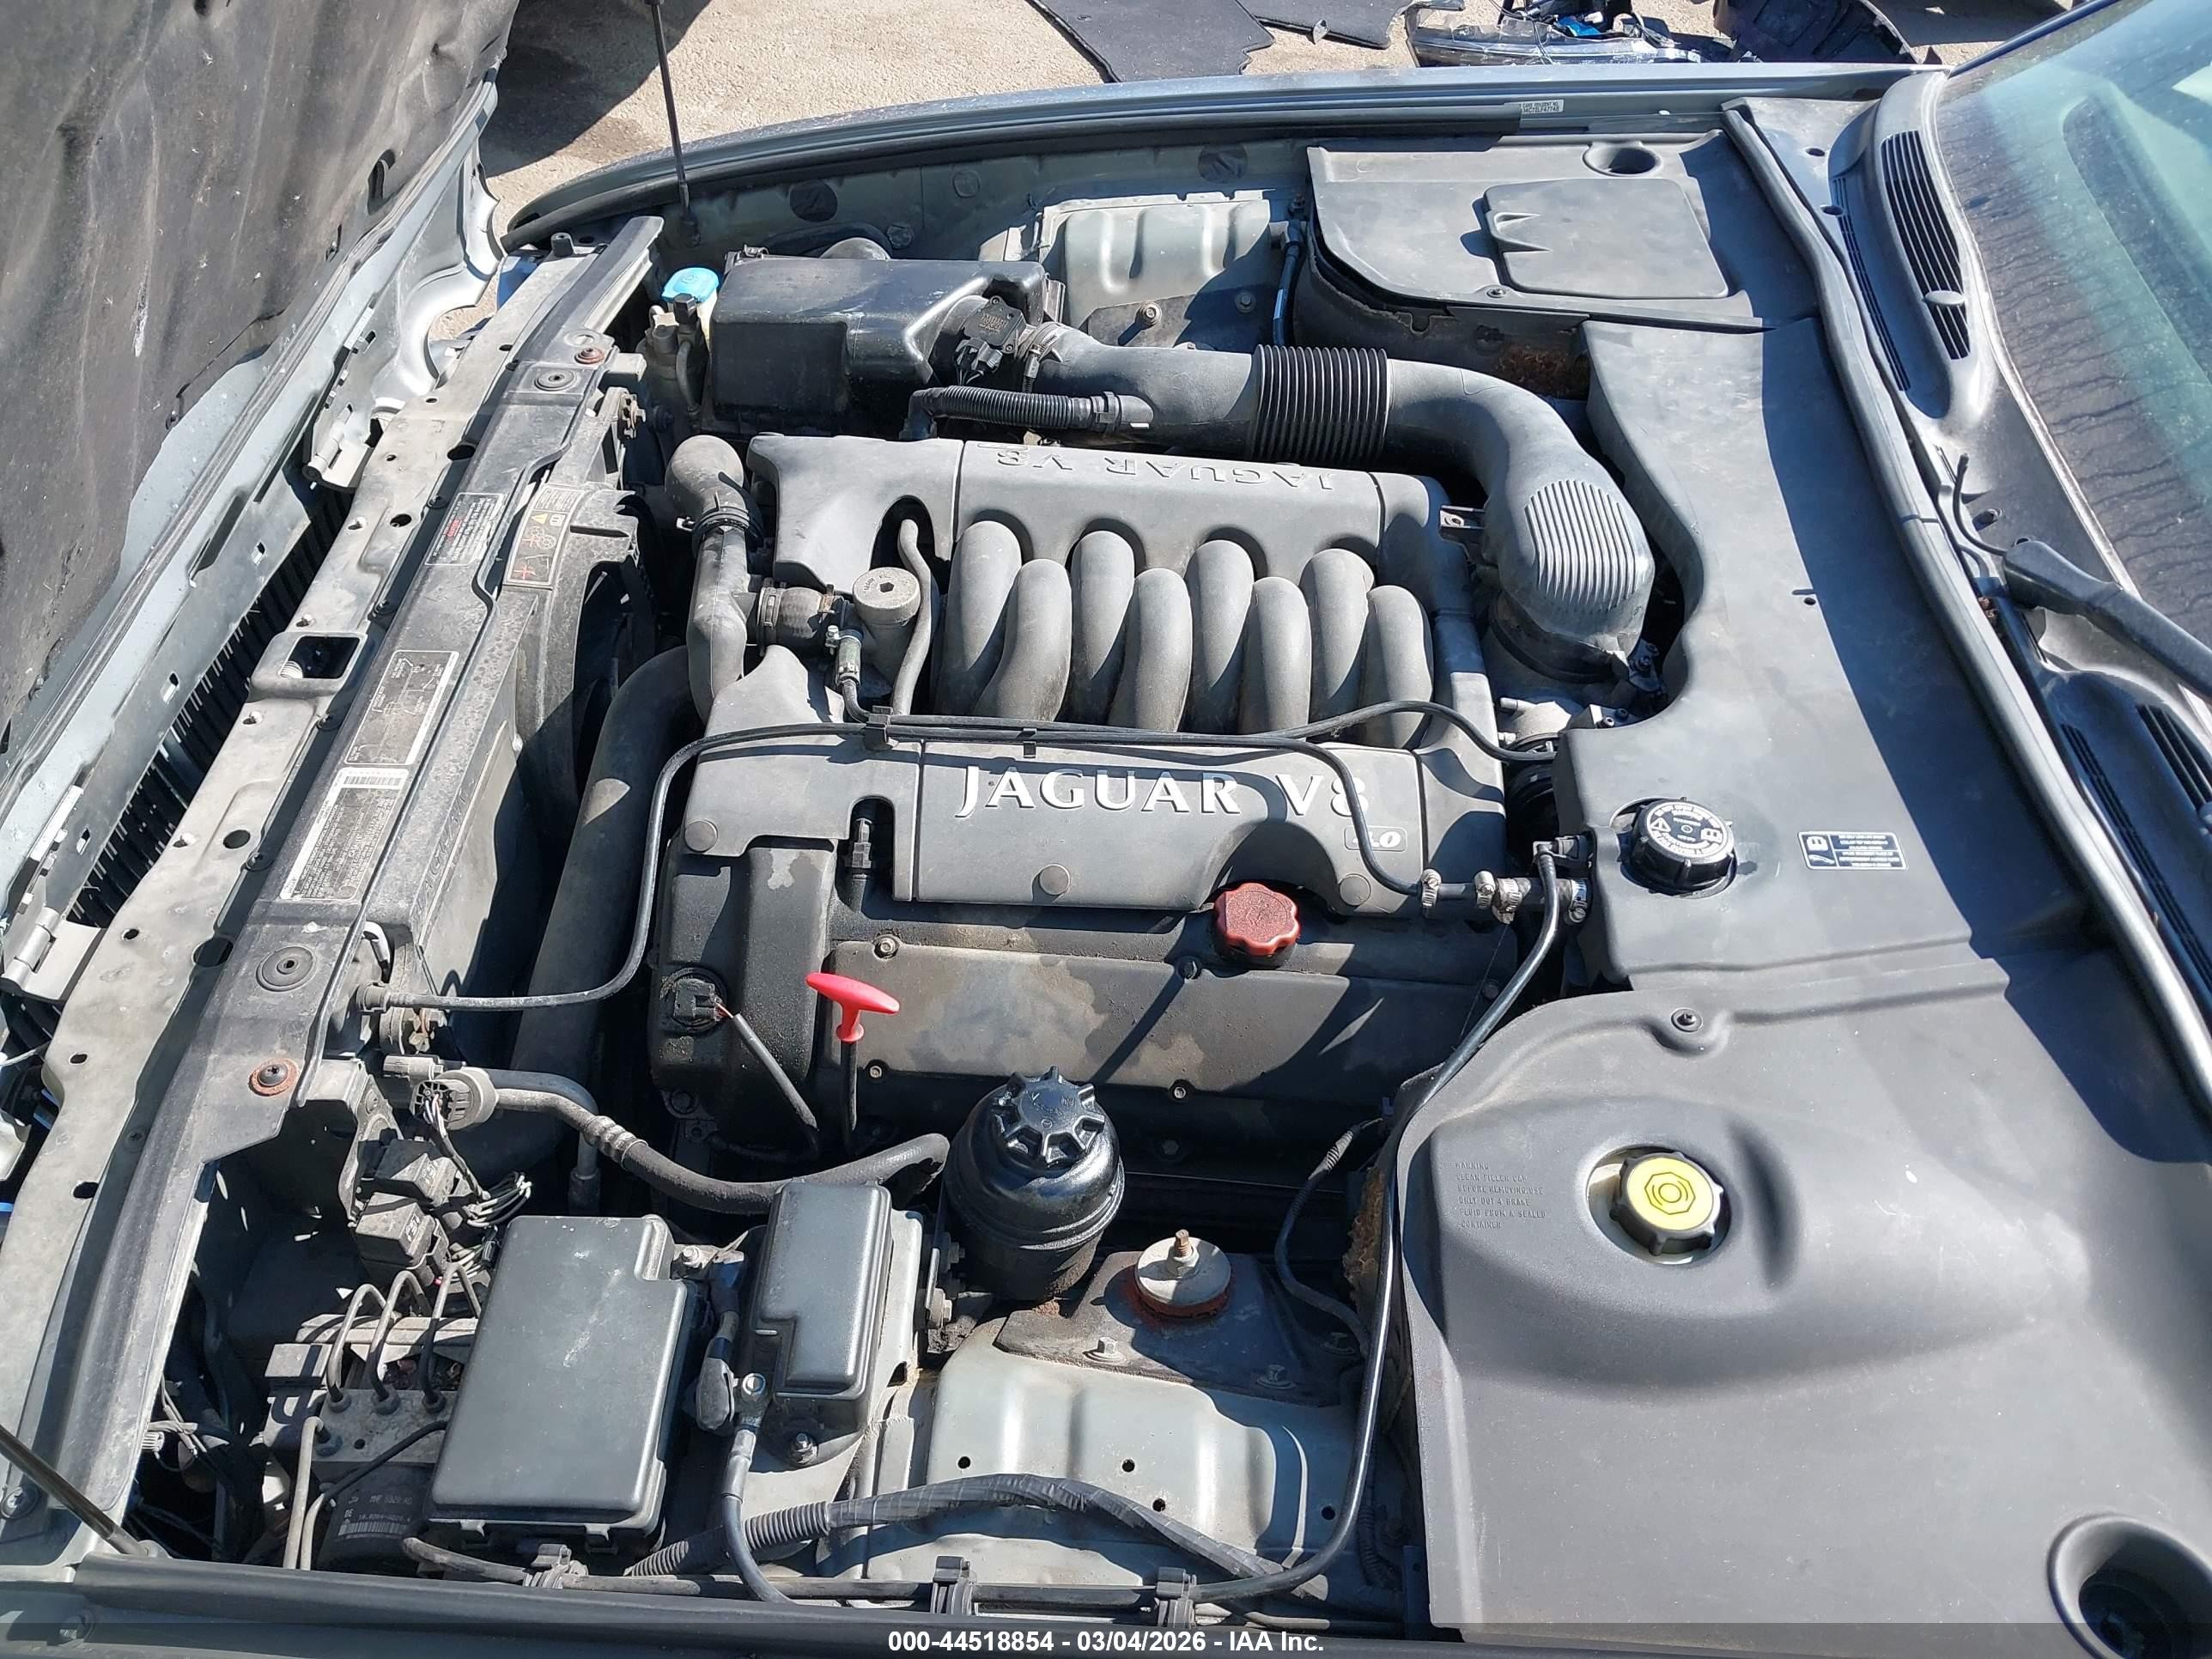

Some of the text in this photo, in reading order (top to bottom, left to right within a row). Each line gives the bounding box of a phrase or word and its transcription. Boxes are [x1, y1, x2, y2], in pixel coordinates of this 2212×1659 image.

[996, 449, 1334, 489] JAGUAR V8
[954, 765, 1370, 818] JAGUAR V8
[1455, 1161, 1489, 1170] WARNING
[1456, 1173, 1480, 1182] CLEAN
[1459, 1196, 1478, 1205] ONLY
[1480, 1197, 1494, 1206] DOT
[1506, 1198, 1530, 1206] BRAKE
[1460, 1208, 1481, 1217] FLUID
[1509, 1209, 1515, 1218] A
[1517, 1210, 1547, 1218] SEALED
[1461, 1220, 1502, 1230] CONTAINER
